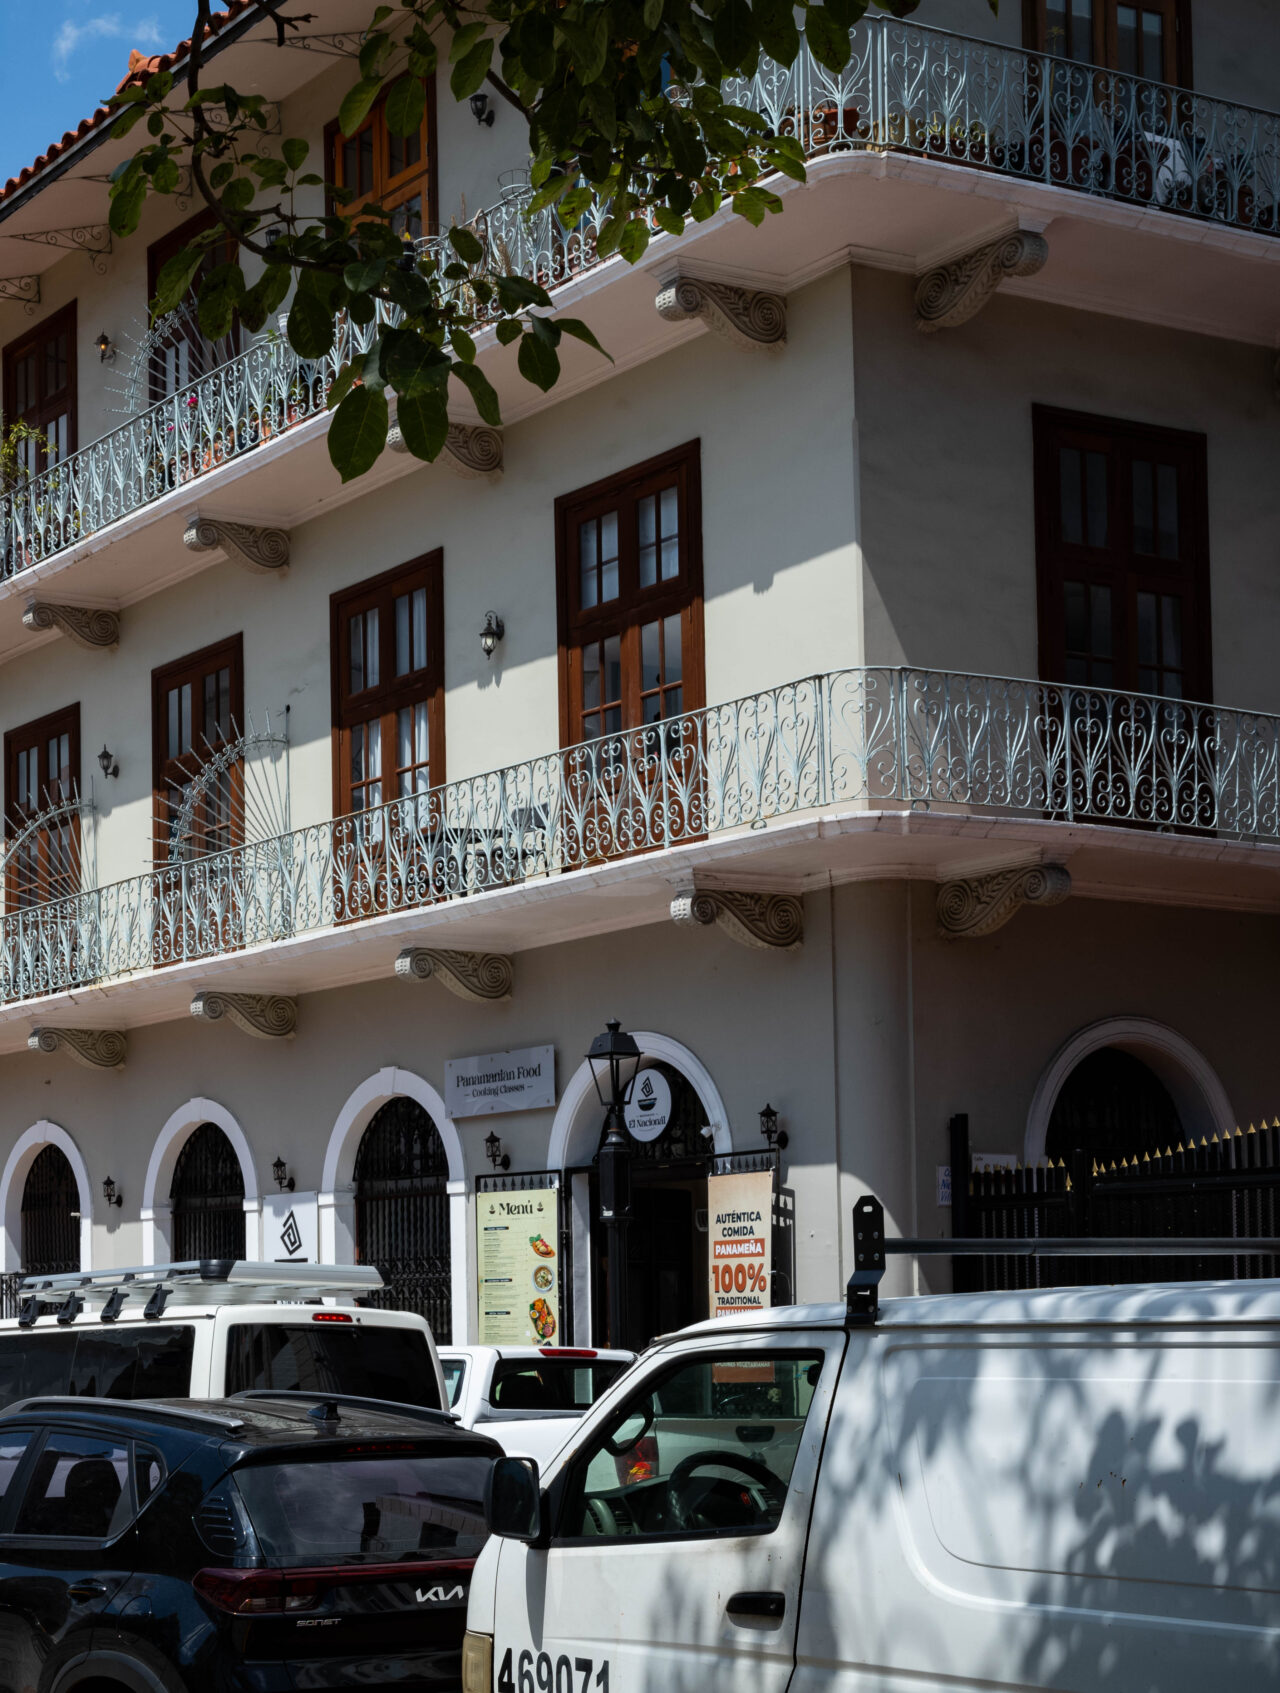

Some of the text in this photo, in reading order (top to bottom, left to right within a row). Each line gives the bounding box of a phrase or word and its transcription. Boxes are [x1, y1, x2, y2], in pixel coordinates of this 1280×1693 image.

[456, 1063, 541, 1088] Panamanian Food
[472, 1083, 525, 1098] Cooking Classes
[629, 1119, 636, 1129] El
[499, 1200, 533, 1215] Menú
[716, 1210, 762, 1224] AUTÉNTICA
[722, 1226, 755, 1237] COMIDA
[716, 1240, 762, 1256] PANAMEÑA
[712, 1263, 767, 1293] 100%
[717, 1296, 761, 1305] TRADITIONAL
[415, 1585, 464, 1602] KIA
[296, 1618, 342, 1627] SONET
[497, 1647, 610, 1693] 469071
